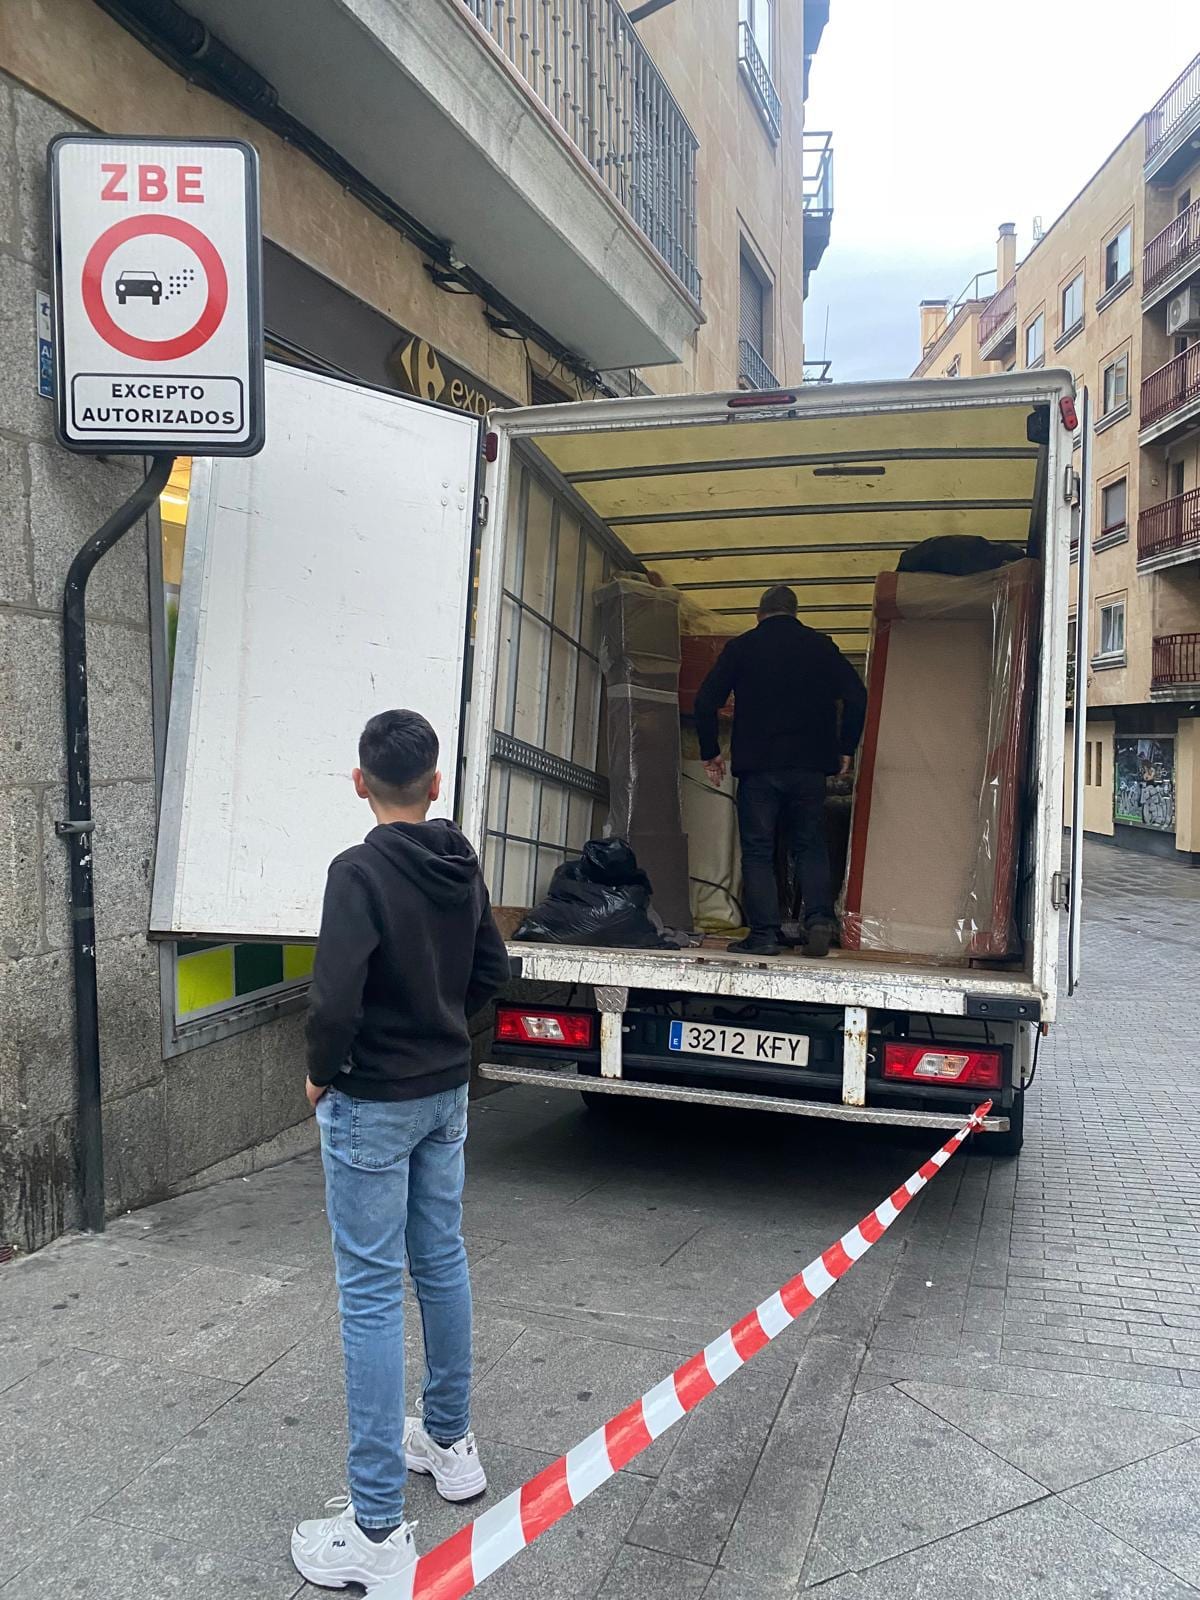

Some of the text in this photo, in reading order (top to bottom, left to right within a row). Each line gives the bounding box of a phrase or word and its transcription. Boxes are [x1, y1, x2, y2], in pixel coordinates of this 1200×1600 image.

[101, 163, 205, 204] ZBE
[111, 383, 205, 400] EXCEPTO
[82, 407, 235, 425] AUTORIZADOS
[688, 1027, 801, 1061] 3212 KFY
